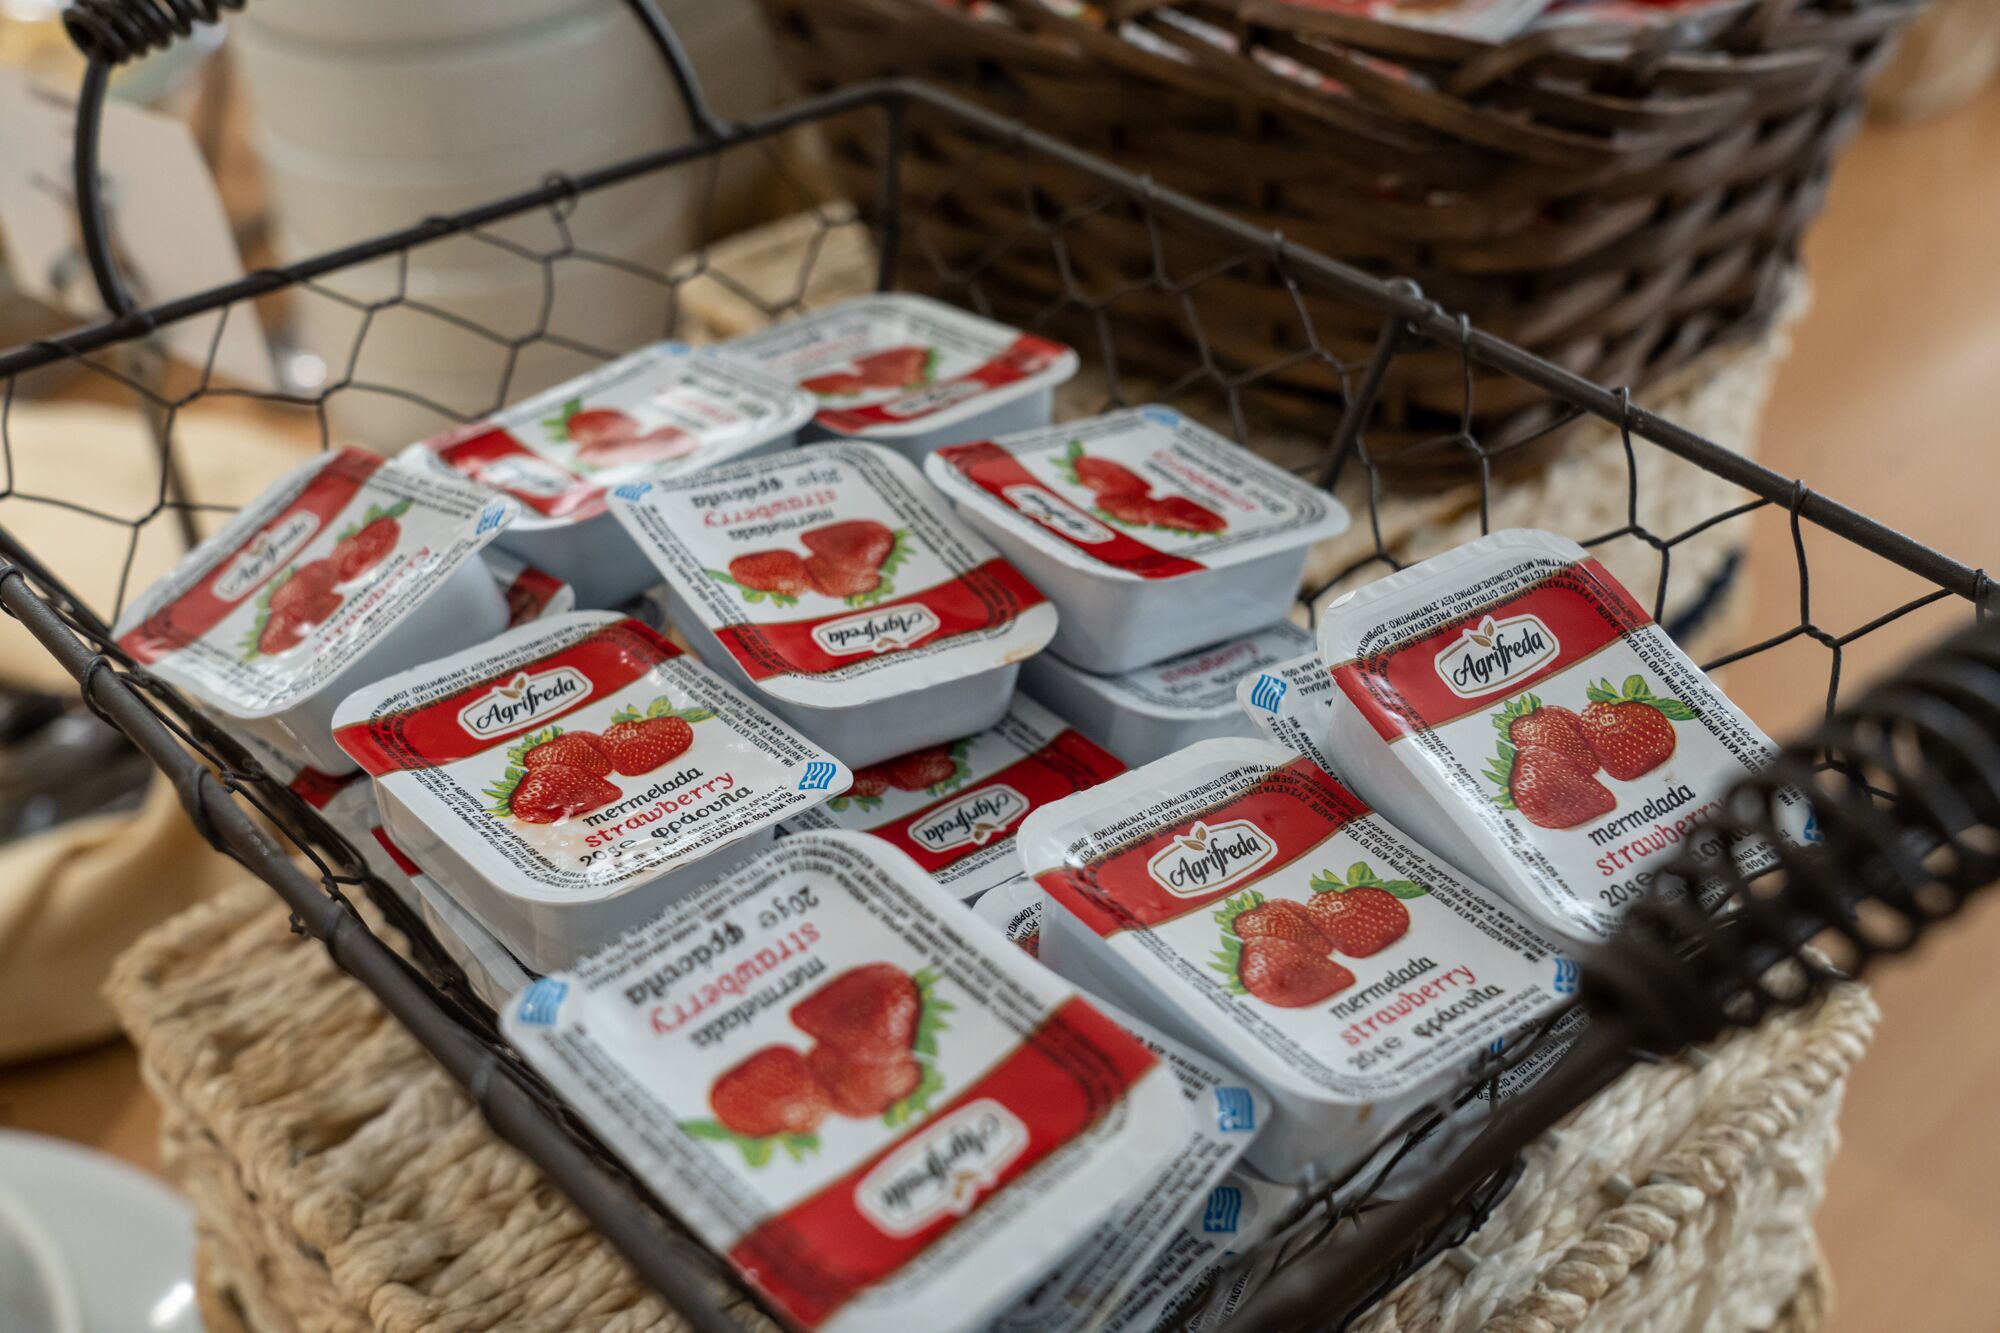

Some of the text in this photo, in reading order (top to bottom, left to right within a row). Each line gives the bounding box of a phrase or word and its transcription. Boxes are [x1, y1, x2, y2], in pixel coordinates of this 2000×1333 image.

[702, 488, 838, 529] strawberry
[727, 509, 837, 543] mermelada
[1384, 600, 1440, 630] ΣΥΝΤΗΡΗΤΙΚΟ:
[1385, 564, 1552, 643] PECTIN, ACID: CITRIC ACID, PRESERVATIVE:
[827, 610, 924, 648] Agrifreda
[1358, 621, 1390, 650] ΣΟΡΒΙΚΟ
[1452, 628, 1546, 687] Agrifreda
[1637, 648, 1652, 663] ΤΟ
[1647, 658, 1666, 678] ΑΠΟ
[1673, 658, 1700, 686] ΣΙΡΟΠΙ
[476, 677, 576, 730] Agrifreda
[1644, 640, 1749, 749] 45% FRUIT, SUGAR, GLUCOSE
[1661, 673, 1682, 695] ΠΡΙΝ
[1262, 713, 1299, 750] ΣΥΣΤΑΤΙΚ
[1678, 690, 1722, 737] ΠΡΟΤΙΜΗΣΗ
[1273, 718, 1323, 767] INGREDIEN
[1293, 729, 1336, 772] ΑΝΑΛΩΣΗΣ
[1718, 732, 1741, 756] ΚΑΤΑ
[452, 783, 487, 814] AGRIFREDA
[583, 767, 704, 827] mermelada
[584, 772, 735, 848] strawberry
[650, 785, 754, 840] φράουλα
[1093, 772, 1262, 852] PECTIN, ACID: CITRIC ACID, PRESERVATIVE:
[1588, 785, 1696, 847] mermelada
[922, 792, 1010, 843] Agrifreda
[1090, 810, 1147, 842] ΣΥΝΤΗΡΗΤΙΚΟ:
[1169, 832, 1262, 887] Agrifreda
[1358, 836, 1373, 850] ΤΟ
[1364, 828, 1405, 860] GLUCOSE
[1370, 845, 1391, 863] ΑΠΟ
[1388, 857, 1409, 876] ΠΡΙΝ
[1403, 855, 1438, 883] SUGAR,
[1406, 870, 1456, 909] ΠΡΟΤΙΜΗΣΗ
[1435, 878, 1465, 903] FRUIT,
[1004, 904, 1035, 934] ΣΟΡΒΙΚΟ
[1454, 904, 1478, 924] ΚΑΤΑ
[650, 921, 821, 1036] strawberry
[1328, 955, 1439, 1020] mermelada
[689, 956, 828, 1050] mermelada
[1340, 964, 1477, 1047] strawberry
[1411, 983, 1505, 1039] φράουλα
[1511, 1054, 1539, 1079] TOTAL
[880, 1112, 1000, 1209] Agrifreda
